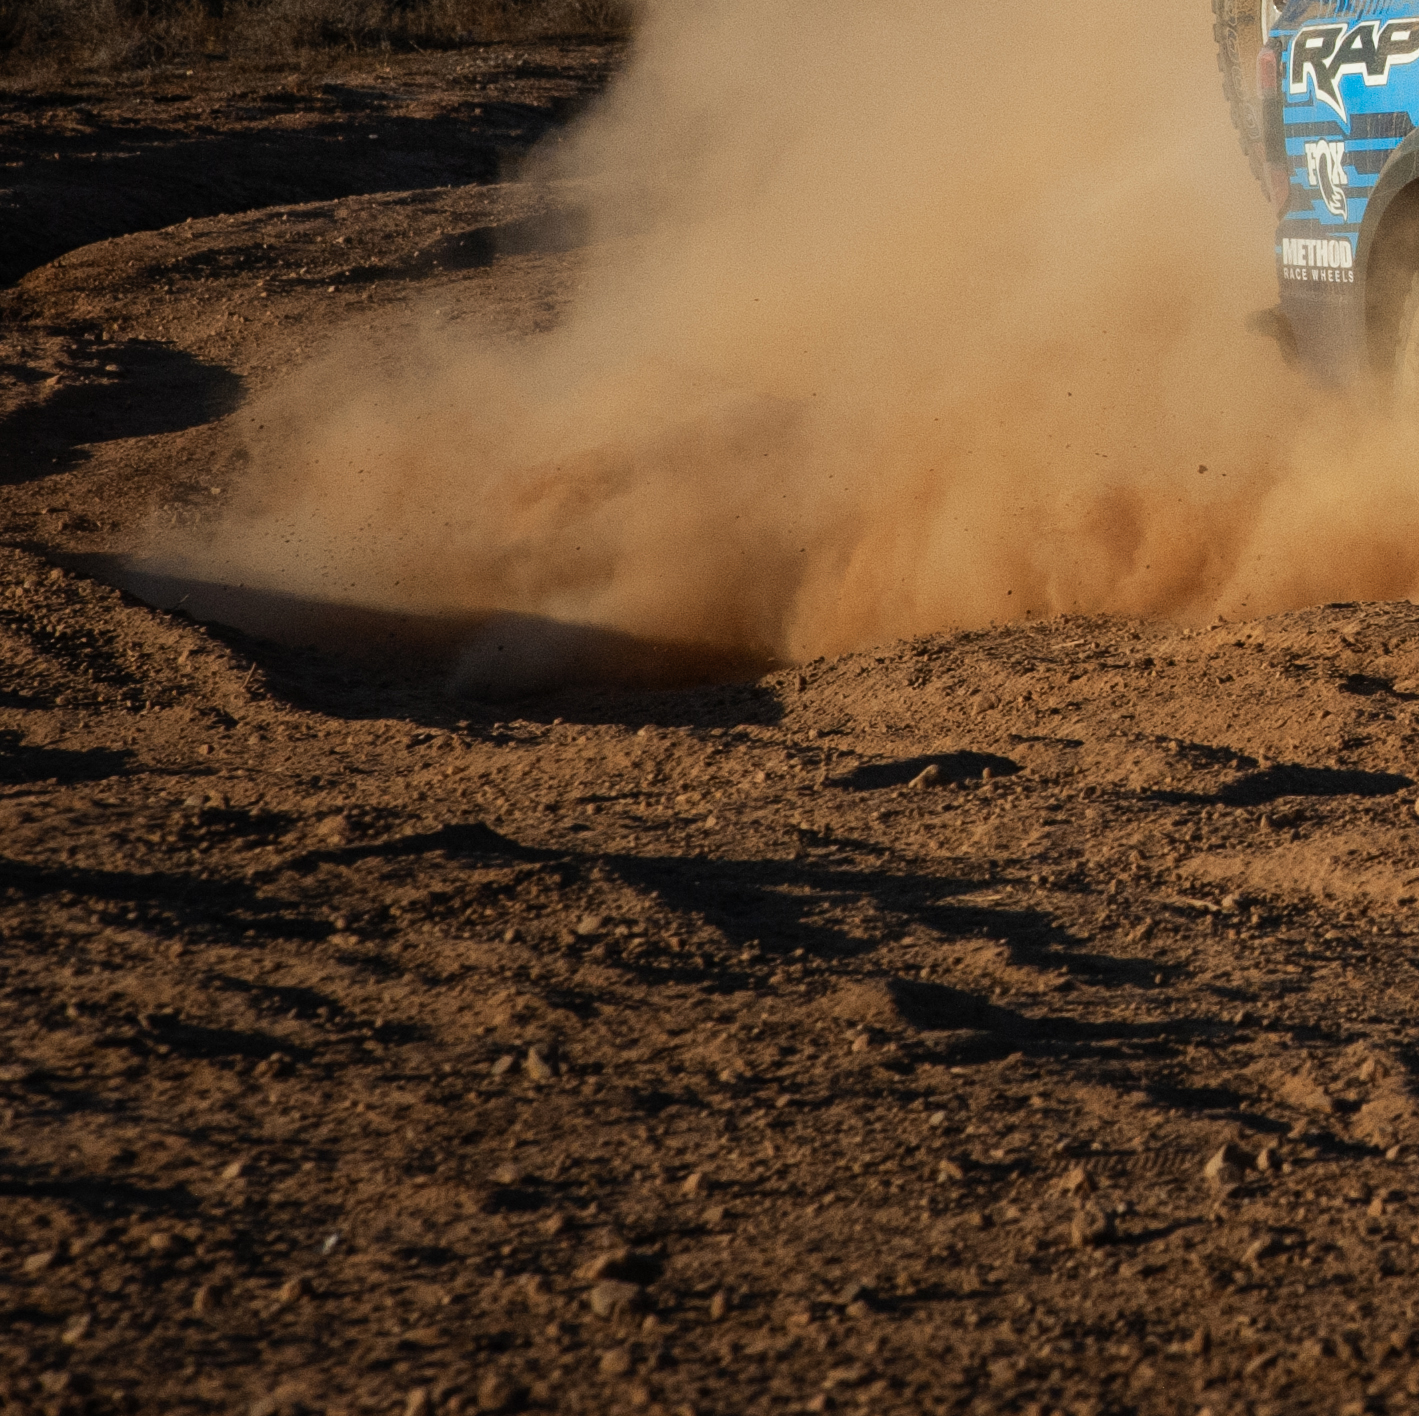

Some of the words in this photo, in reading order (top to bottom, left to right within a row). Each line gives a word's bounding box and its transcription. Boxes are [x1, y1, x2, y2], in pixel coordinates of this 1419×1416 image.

[1304, 139, 1348, 206] FOX
[1282, 238, 1352, 268] METHOD
[1283, 267, 1308, 280] RACE
[1312, 269, 1354, 283] WHEELS
